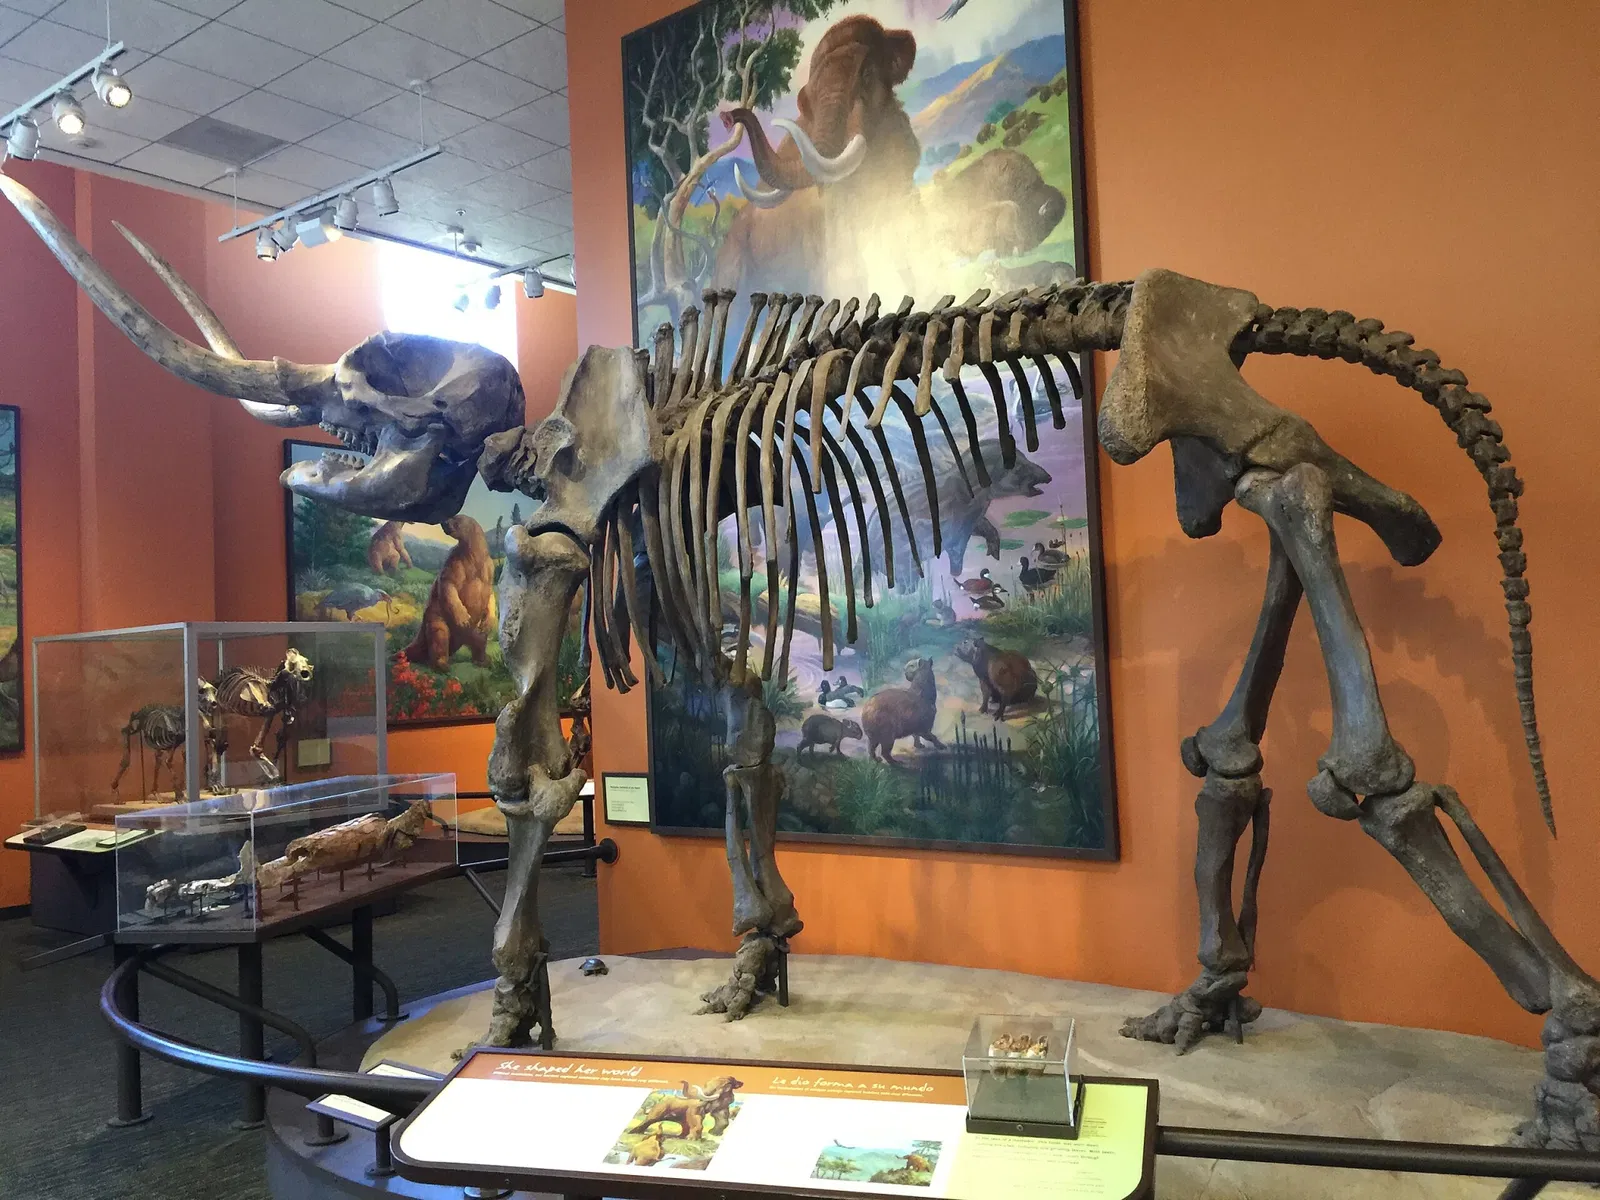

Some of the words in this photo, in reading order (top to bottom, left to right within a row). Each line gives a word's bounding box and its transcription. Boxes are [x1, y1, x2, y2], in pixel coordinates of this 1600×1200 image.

[495, 1060, 520, 1070] She
[524, 1062, 574, 1075] shaped
[574, 1064, 599, 1074] her
[602, 1066, 643, 1077] world
[772, 1076, 787, 1085] Le
[813, 1077, 854, 1088] forma
[890, 1082, 934, 1092] mundo
